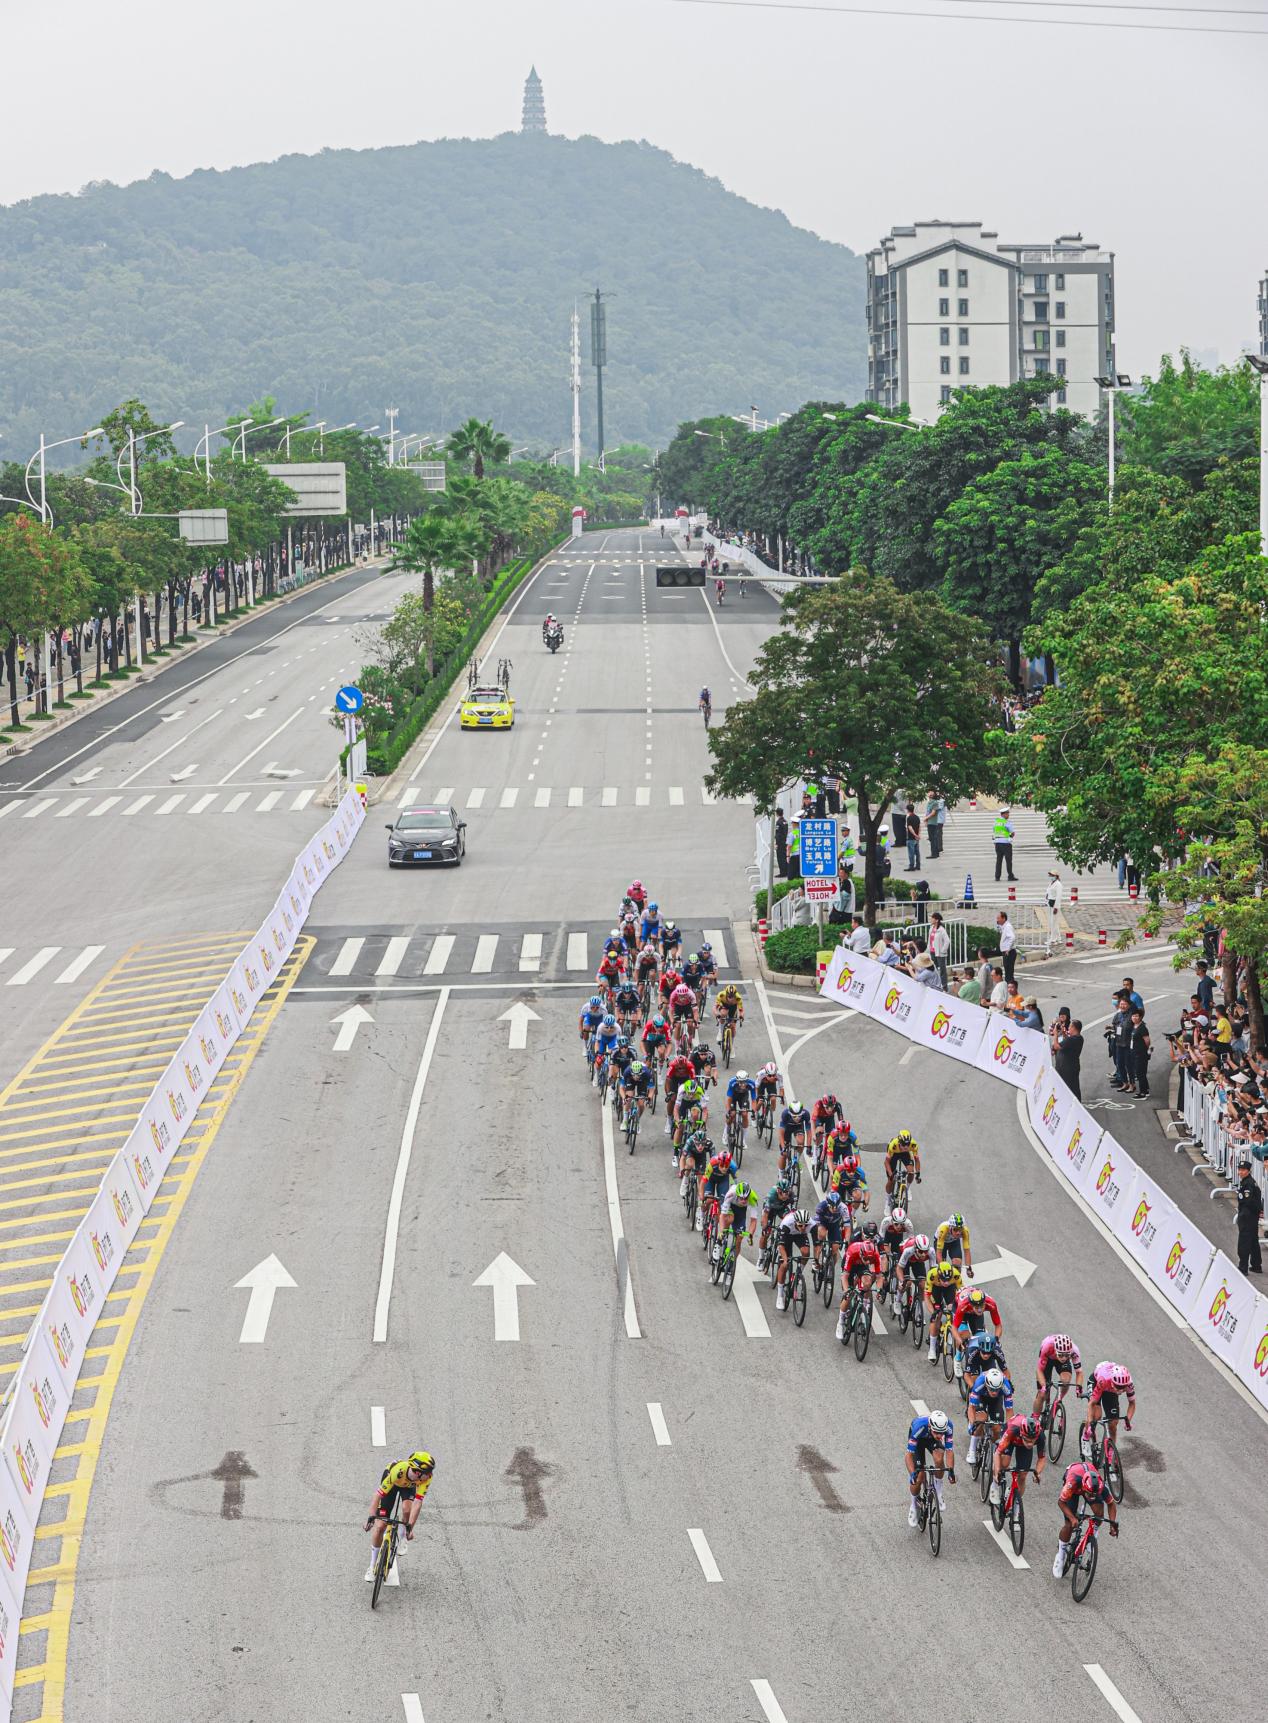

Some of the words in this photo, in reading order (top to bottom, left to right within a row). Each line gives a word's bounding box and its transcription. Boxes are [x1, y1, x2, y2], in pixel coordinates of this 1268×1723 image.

[949, 1025, 967, 1041] 环广西
[1010, 1051, 1027, 1067] 环广西
